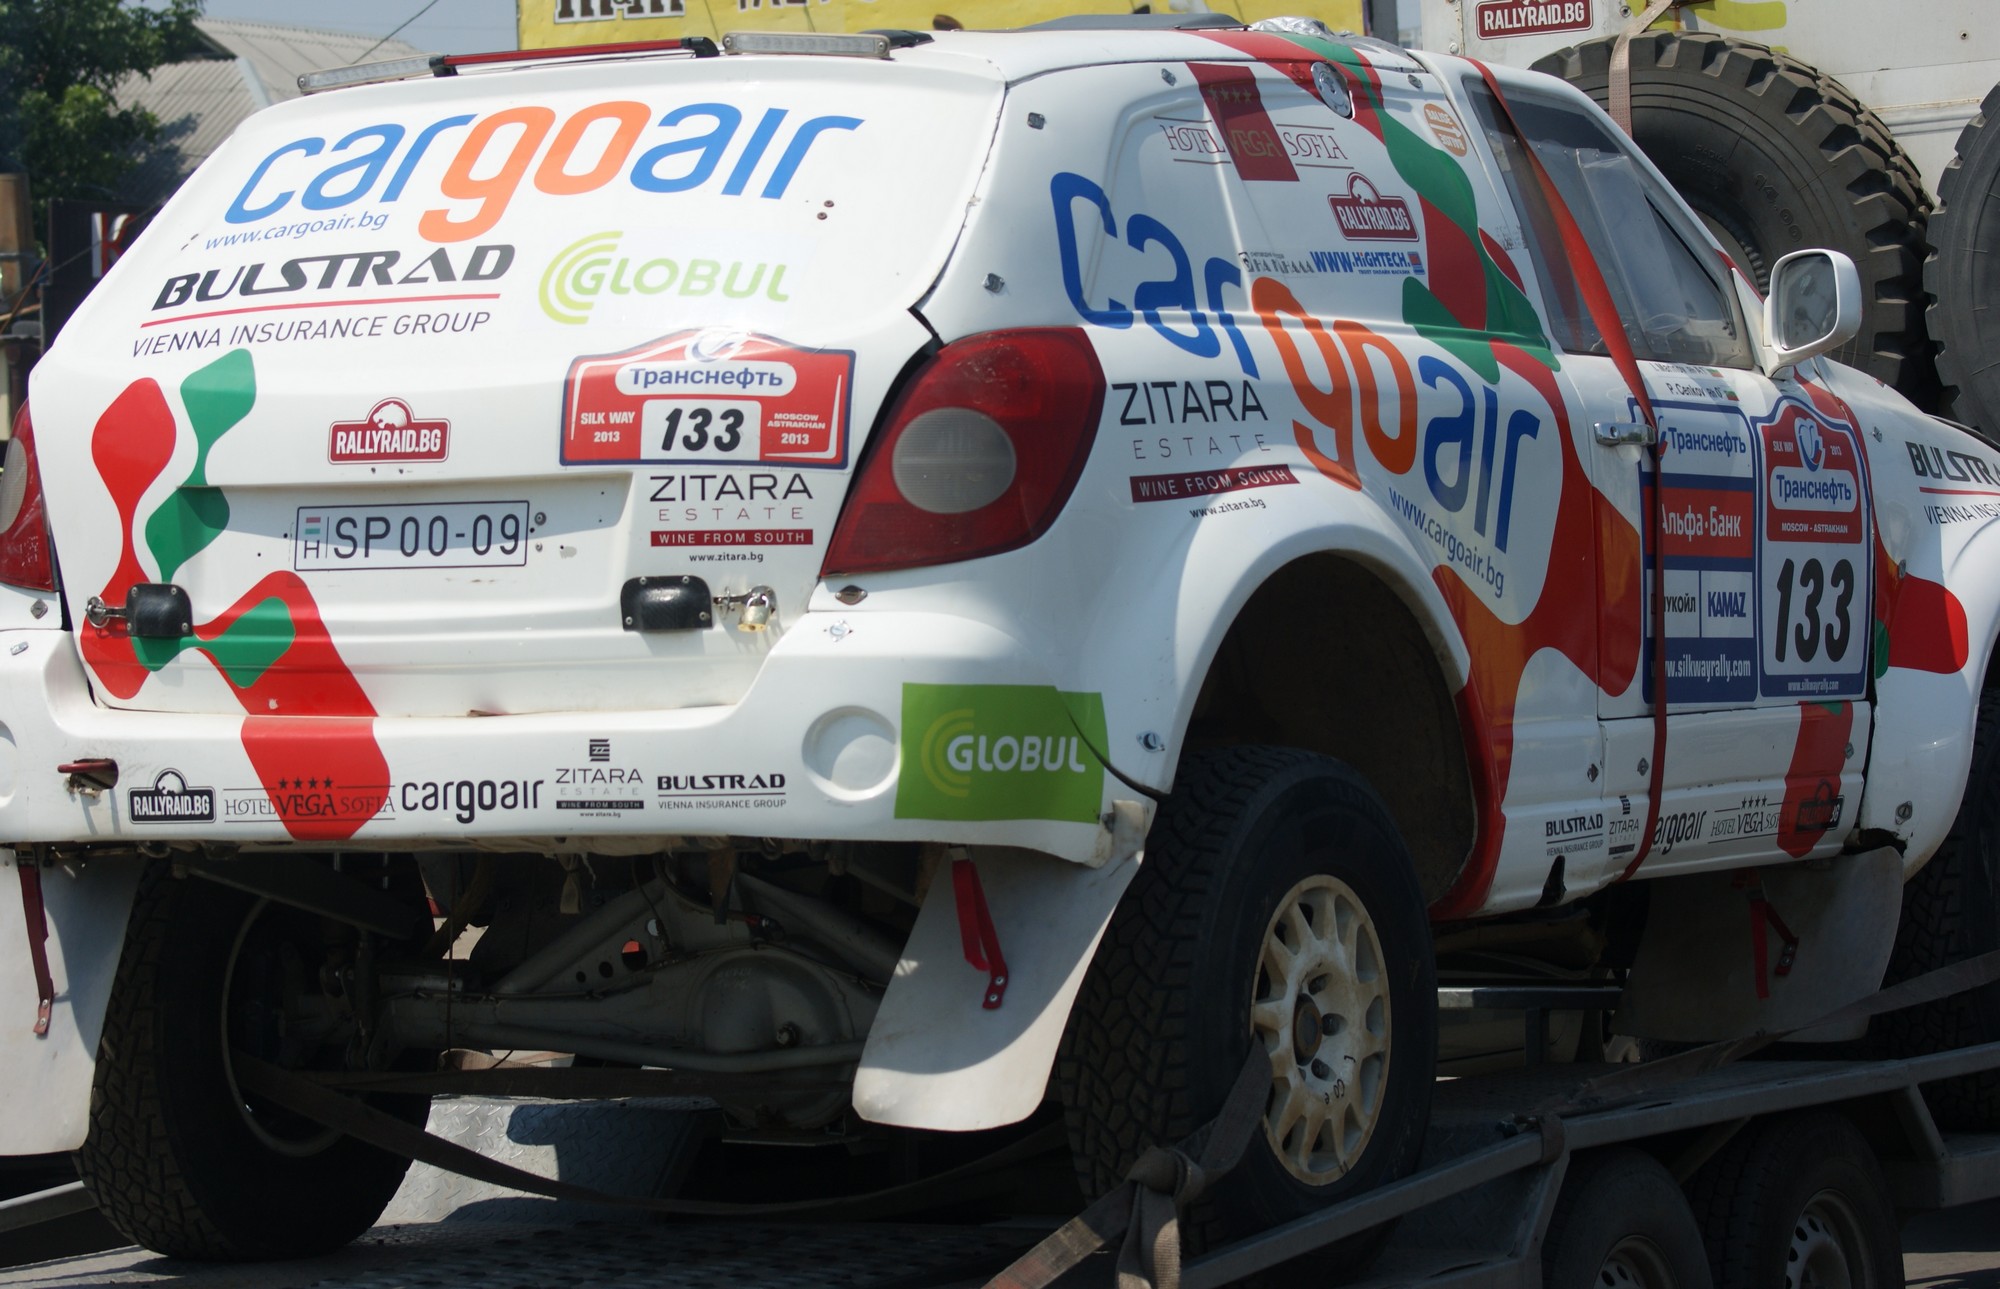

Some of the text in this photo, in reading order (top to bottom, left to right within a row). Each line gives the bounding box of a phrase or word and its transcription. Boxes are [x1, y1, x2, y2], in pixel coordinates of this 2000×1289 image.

[1483, 1, 1585, 31] RALLYRAID.BG
[1160, 124, 1348, 160] HOTEL VEGA SOFIA
[225, 101, 865, 242] cargoair
[205, 210, 389, 250] www.cargoair.bg
[1336, 205, 1411, 231] RALLYRAID.BG
[151, 244, 515, 311] BULSTRAD
[571, 257, 789, 302] GLOBUL
[132, 311, 491, 358] VIENNA INSURANCE GROUP
[1050, 172, 1540, 553] cargoair
[629, 367, 783, 389] Транснефть
[1112, 380, 1269, 426] ZITARA
[580, 411, 636, 425] SILK WAY
[661, 407, 744, 452] 133
[767, 420, 826, 429] ASTRAKHAN
[774, 412, 819, 421] MOSCOW
[335, 427, 442, 455] RALLYRAID.BG
[593, 431, 620, 443] 2013
[781, 433, 810, 445] 2013
[1132, 433, 1271, 460] ESTATE
[1667, 427, 1747, 457] Транснефть
[650, 473, 814, 502] ZITARA
[1139, 467, 1290, 497] WINE FROM SOUTH
[1776, 474, 1852, 505] Транснефть
[659, 507, 804, 521] ESTATE
[1190, 496, 1267, 519] www.zitara.bg
[1924, 504, 1978, 526] VIENNA
[659, 531, 805, 544] WINE FROM SOUTH
[1781, 523, 1808, 533] MOSCOW
[1813, 524, 1848, 534] ASTRAKHAN
[303, 540, 320, 560] H
[1388, 486, 1506, 598] www.cargoair.bg
[689, 551, 764, 562] www.zitara.bg
[1664, 592, 1696, 613] УКОЙЛ
[1707, 591, 1747, 618] KAMAZ
[1775, 558, 1855, 663] 133
[1651, 654, 1751, 682] w.silkwayrally.com
[946, 734, 1086, 773] GLOBUL
[555, 768, 644, 784] ZITARA
[657, 773, 786, 791] BULSTRAD
[401, 779, 544, 824] cargoair
[560, 787, 639, 796] ESTATE
[658, 799, 787, 809] VIENNA INSURANCE GROUP
[133, 794, 210, 816] RALLYRAID.BG
[224, 793, 396, 817] HOTEL VEGA SOFIA
[1546, 814, 1603, 837] BULSTRAD
[1608, 818, 1640, 835] ZITARA
[1652, 811, 1707, 855] argoair
[1710, 818, 1735, 837] HOTEL
[1737, 811, 1763, 835] VEGA
[1546, 847, 1564, 857] VIENNA
[1564, 842, 1588, 853] INSURANCE
